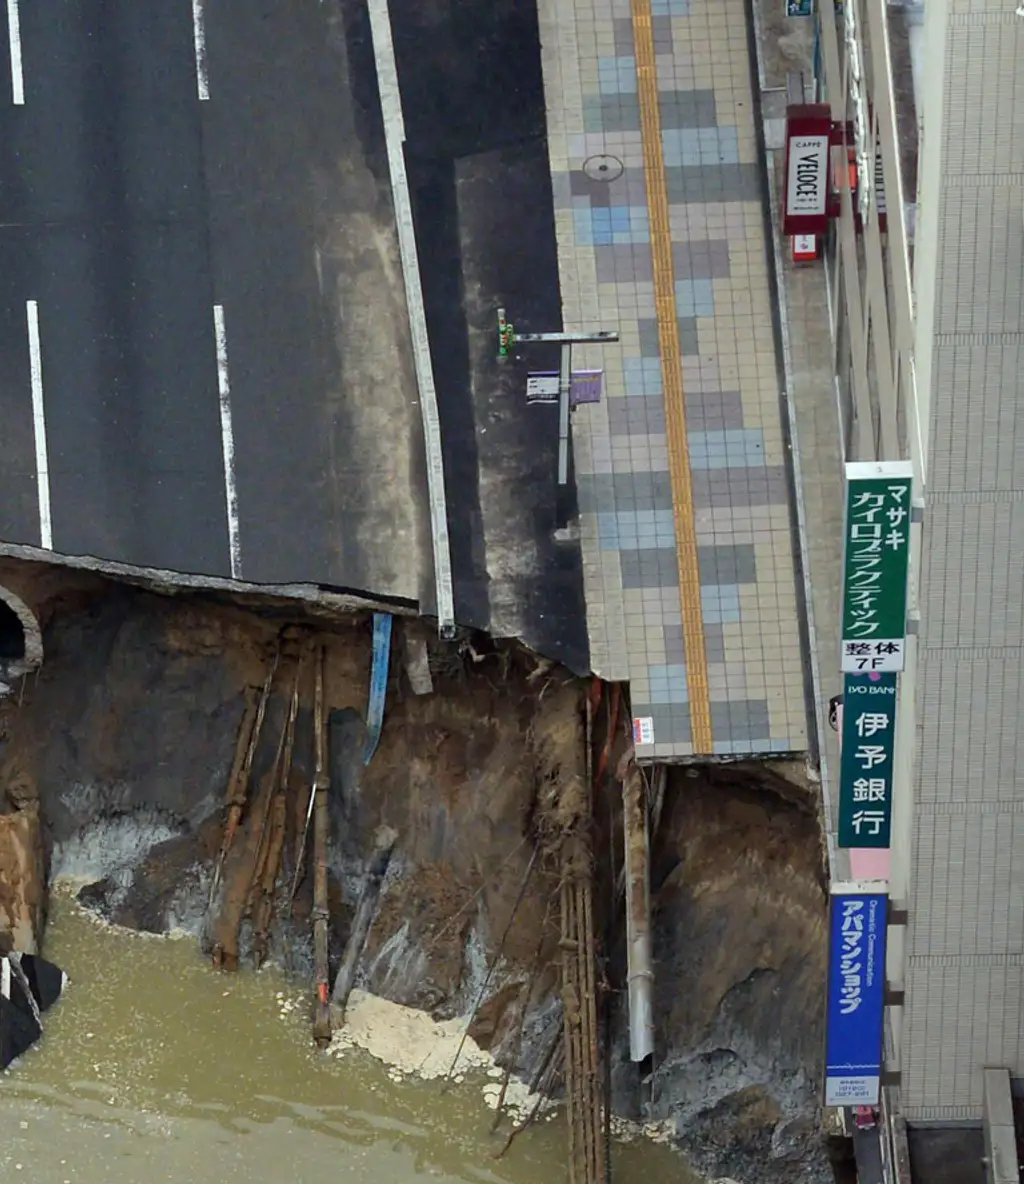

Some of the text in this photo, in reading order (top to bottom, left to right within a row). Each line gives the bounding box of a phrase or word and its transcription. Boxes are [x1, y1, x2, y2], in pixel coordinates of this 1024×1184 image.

[796, 153, 819, 196] VELOCE
[885, 486, 908, 550] マサキ
[846, 492, 886, 637] カイロプラクティック
[845, 642, 900, 655] 整体
[855, 657, 885, 669] 7F
[848, 686, 867, 694] IYO
[852, 712, 889, 835] 伊予銀行
[839, 901, 864, 1013] アパマンショップ
